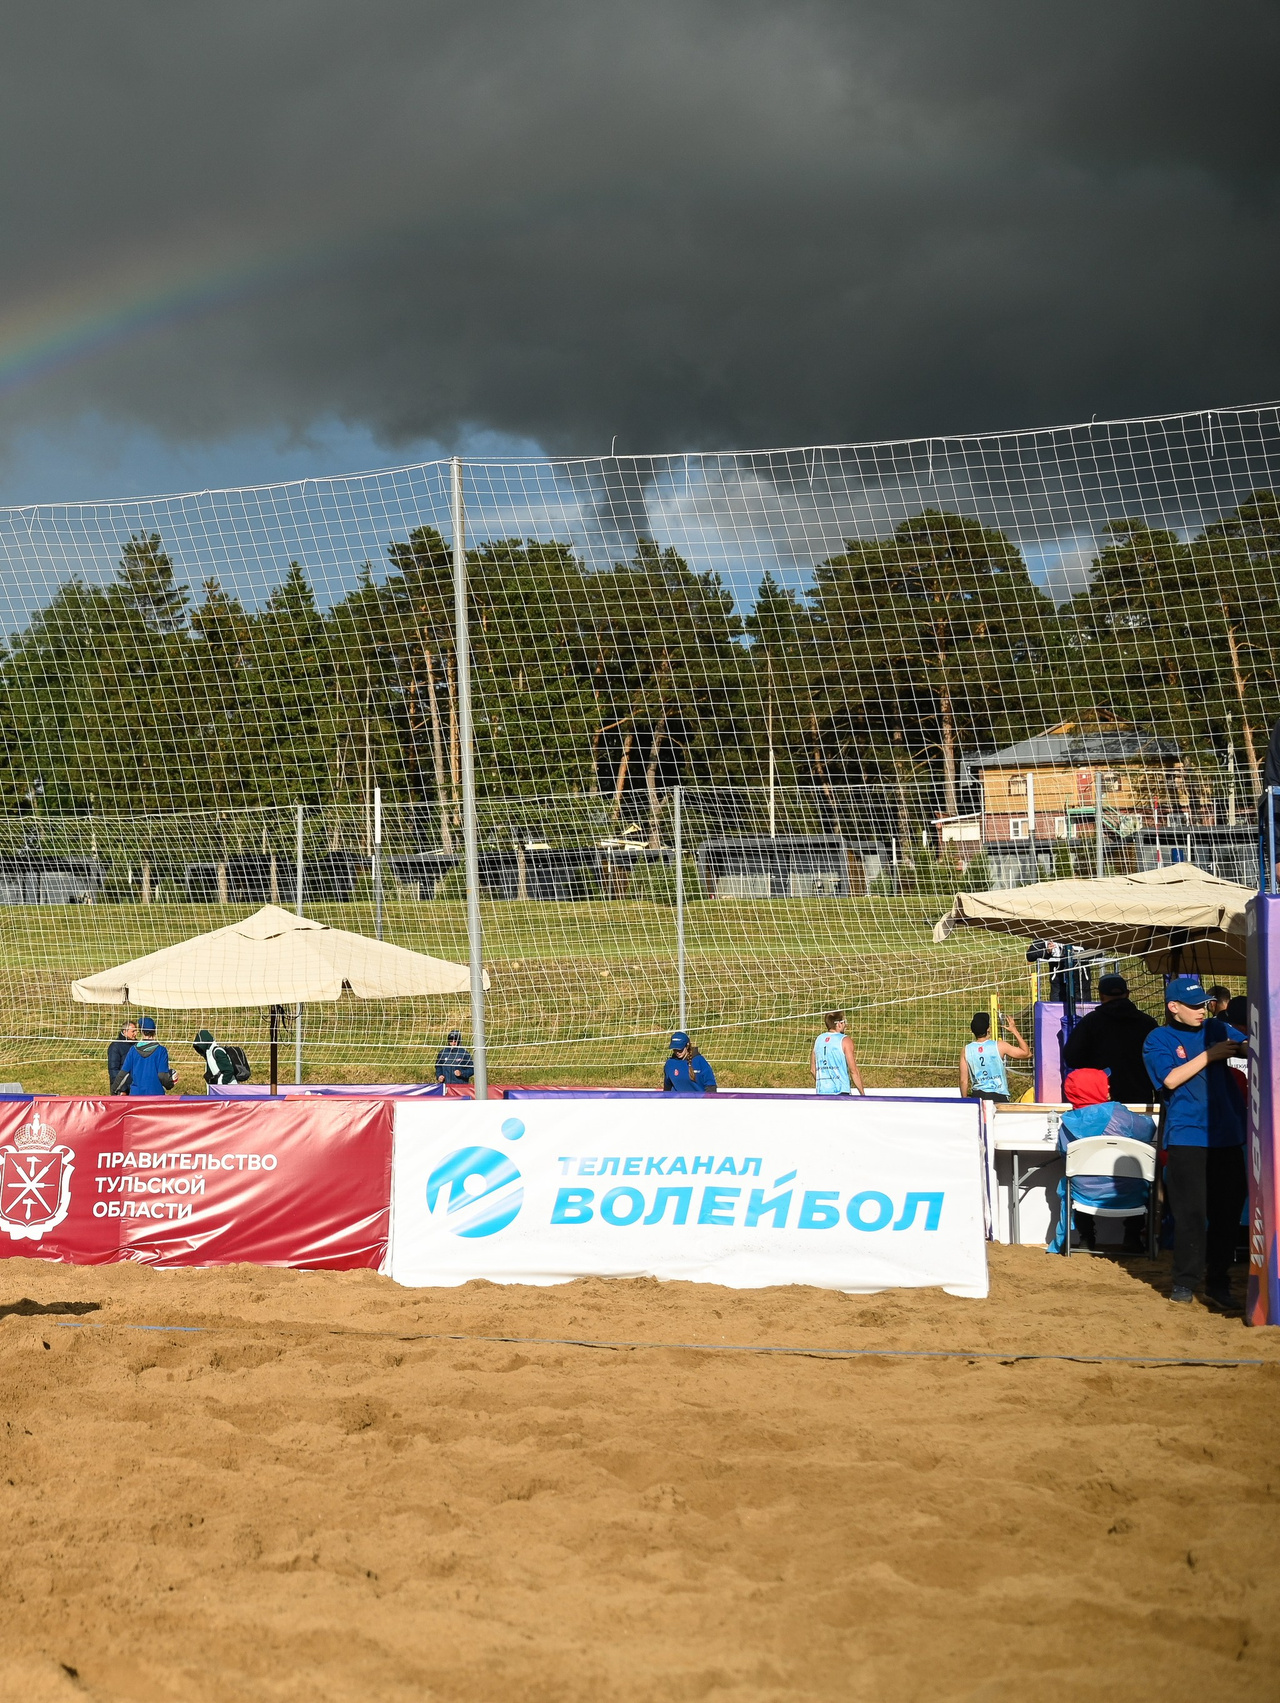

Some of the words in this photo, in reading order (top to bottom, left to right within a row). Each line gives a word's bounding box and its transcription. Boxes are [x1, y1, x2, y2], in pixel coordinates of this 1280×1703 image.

[823, 1045, 827, 1056] 1
[978, 1056, 986, 1067] 2
[97, 1152, 278, 1171] ПРАВИТЕЛЬСТВО
[558, 1155, 763, 1177] ТЕЛЕКАНАЛ
[94, 1174, 206, 1195] ТУЛЬСКОЙ
[92, 1201, 193, 1219] ОБЛАСТИ
[549, 1169, 945, 1233] ВОЛЕЙБОЛ
